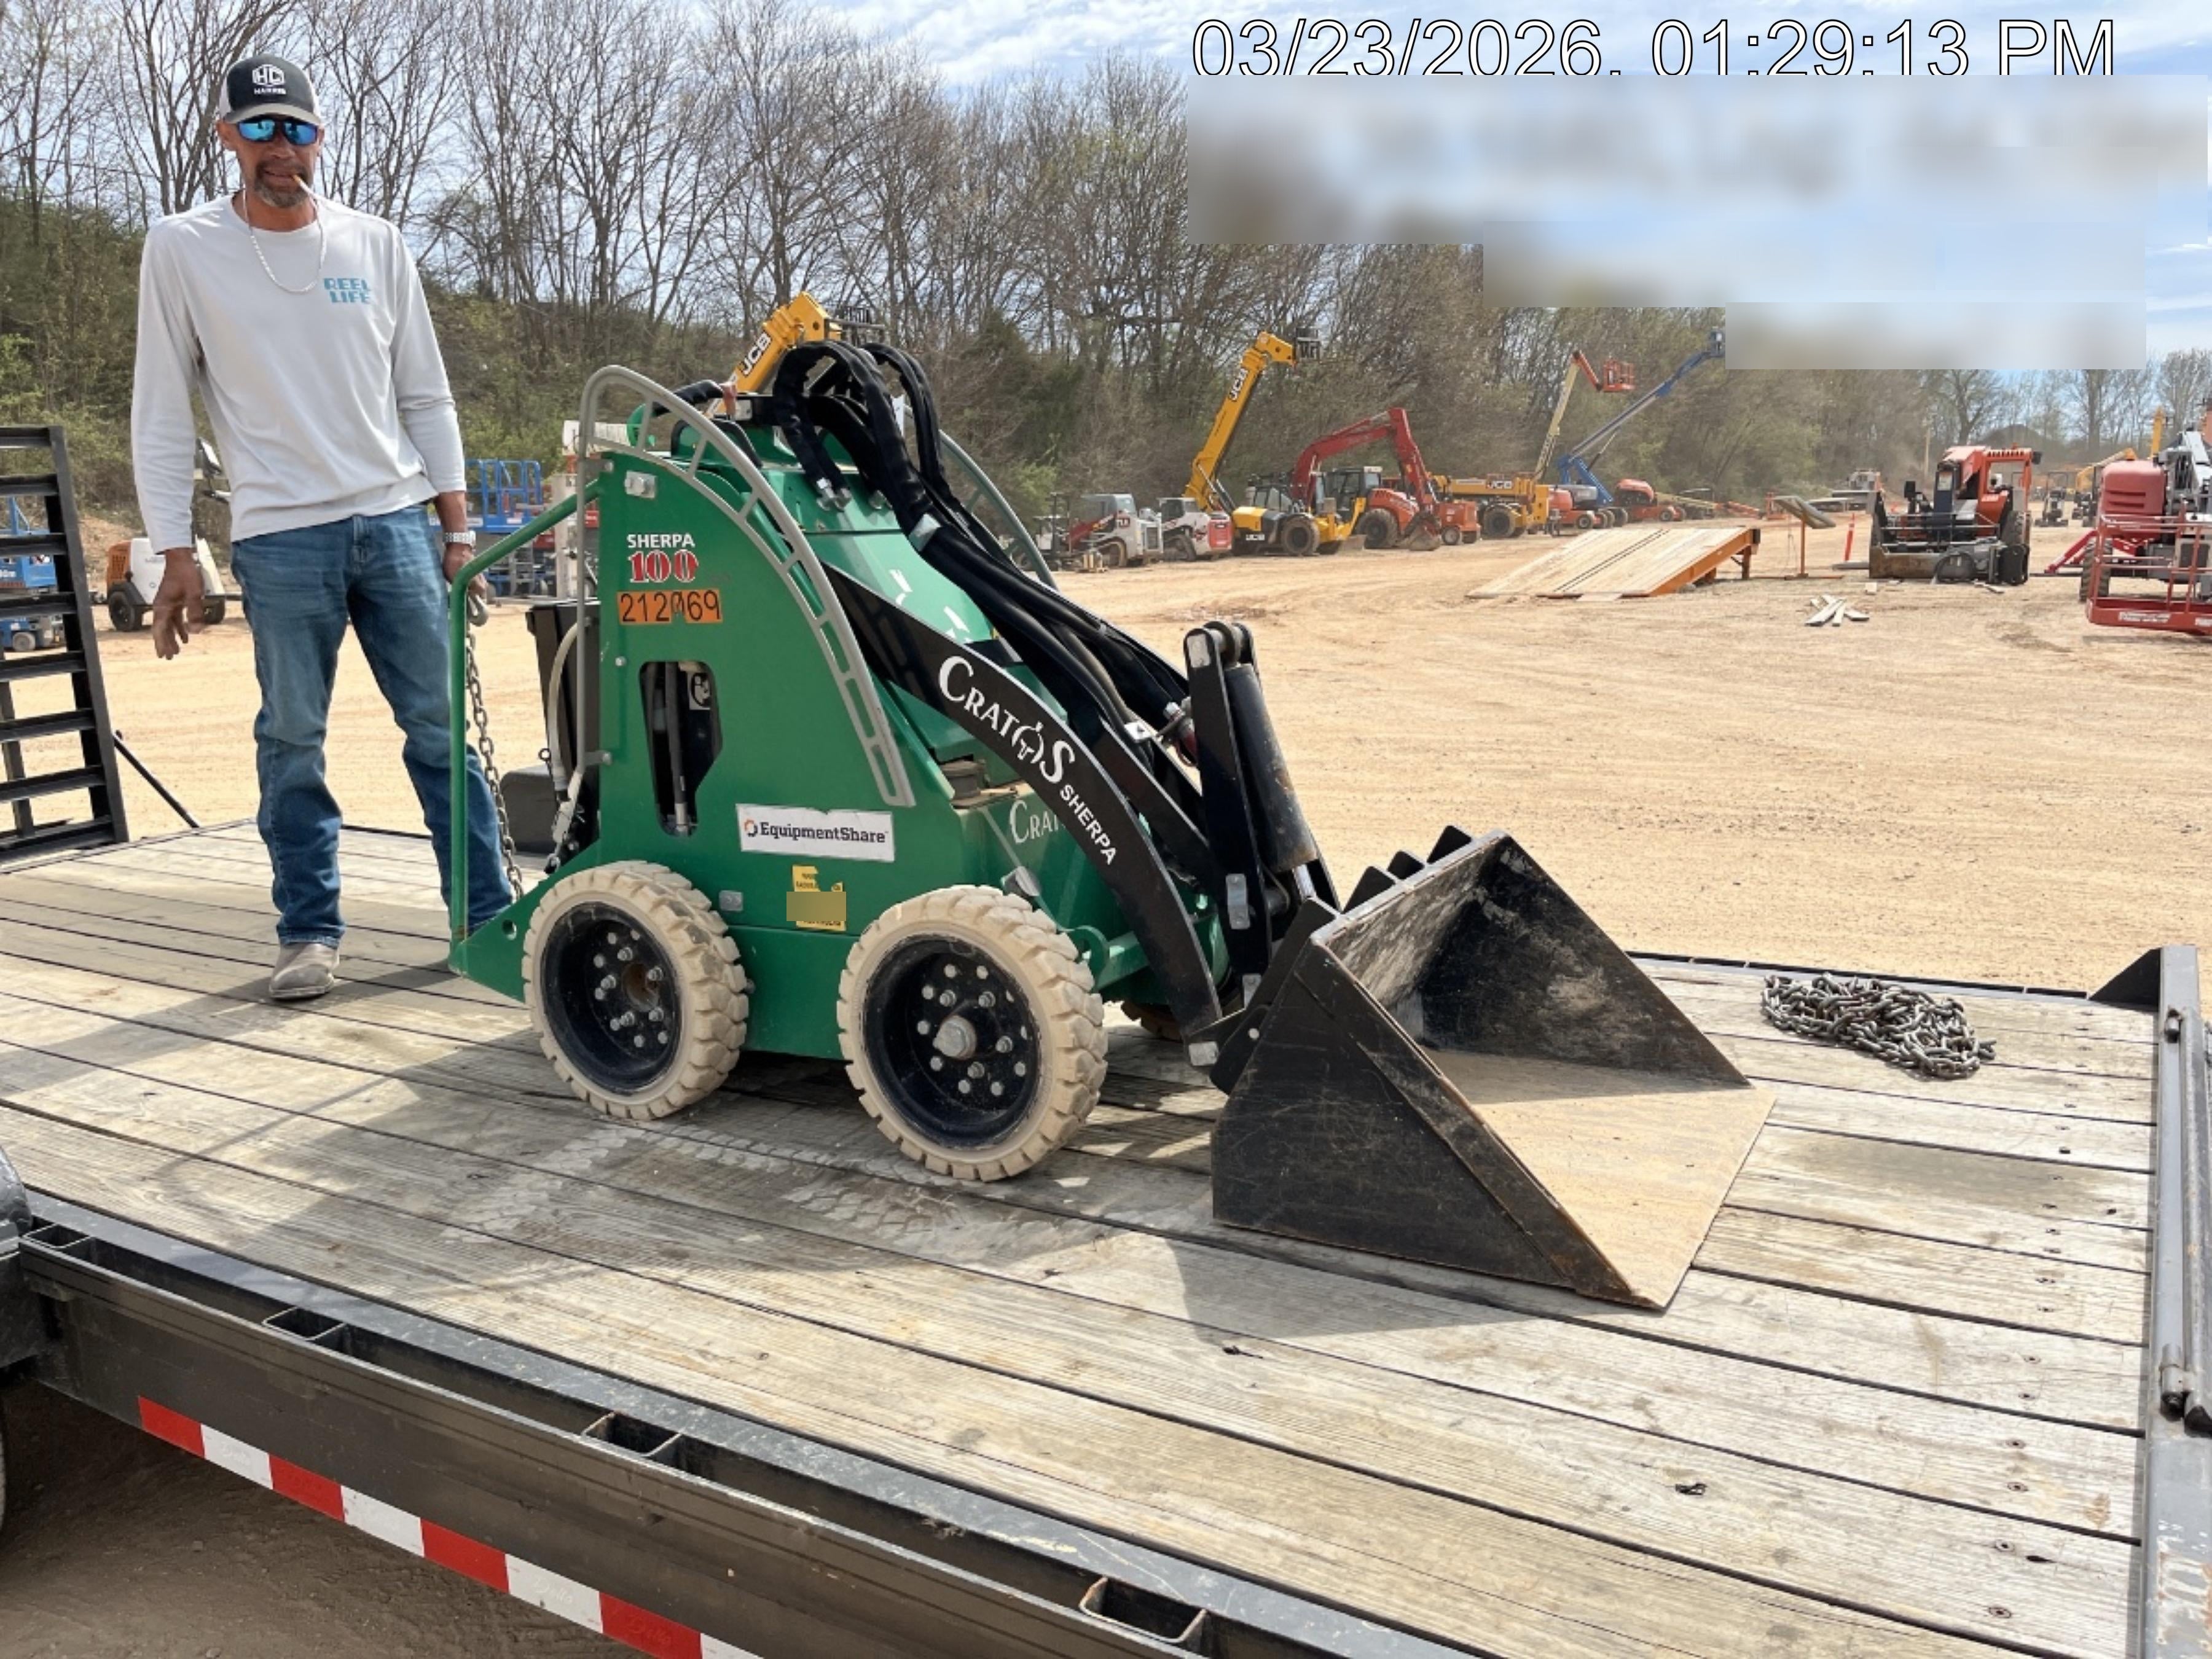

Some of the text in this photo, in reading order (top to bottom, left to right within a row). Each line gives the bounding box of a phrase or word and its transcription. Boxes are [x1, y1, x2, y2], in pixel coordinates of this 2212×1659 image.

[324, 278, 371, 291] REEL
[329, 291, 370, 304] LIFE
[739, 331, 772, 376] JCB
[1230, 368, 1248, 401] JCB
[627, 533, 695, 548] SHERPA
[628, 549, 699, 583] 100
[760, 822, 885, 843] EquipmentShare
[1060, 784, 1117, 865] SHERPA
